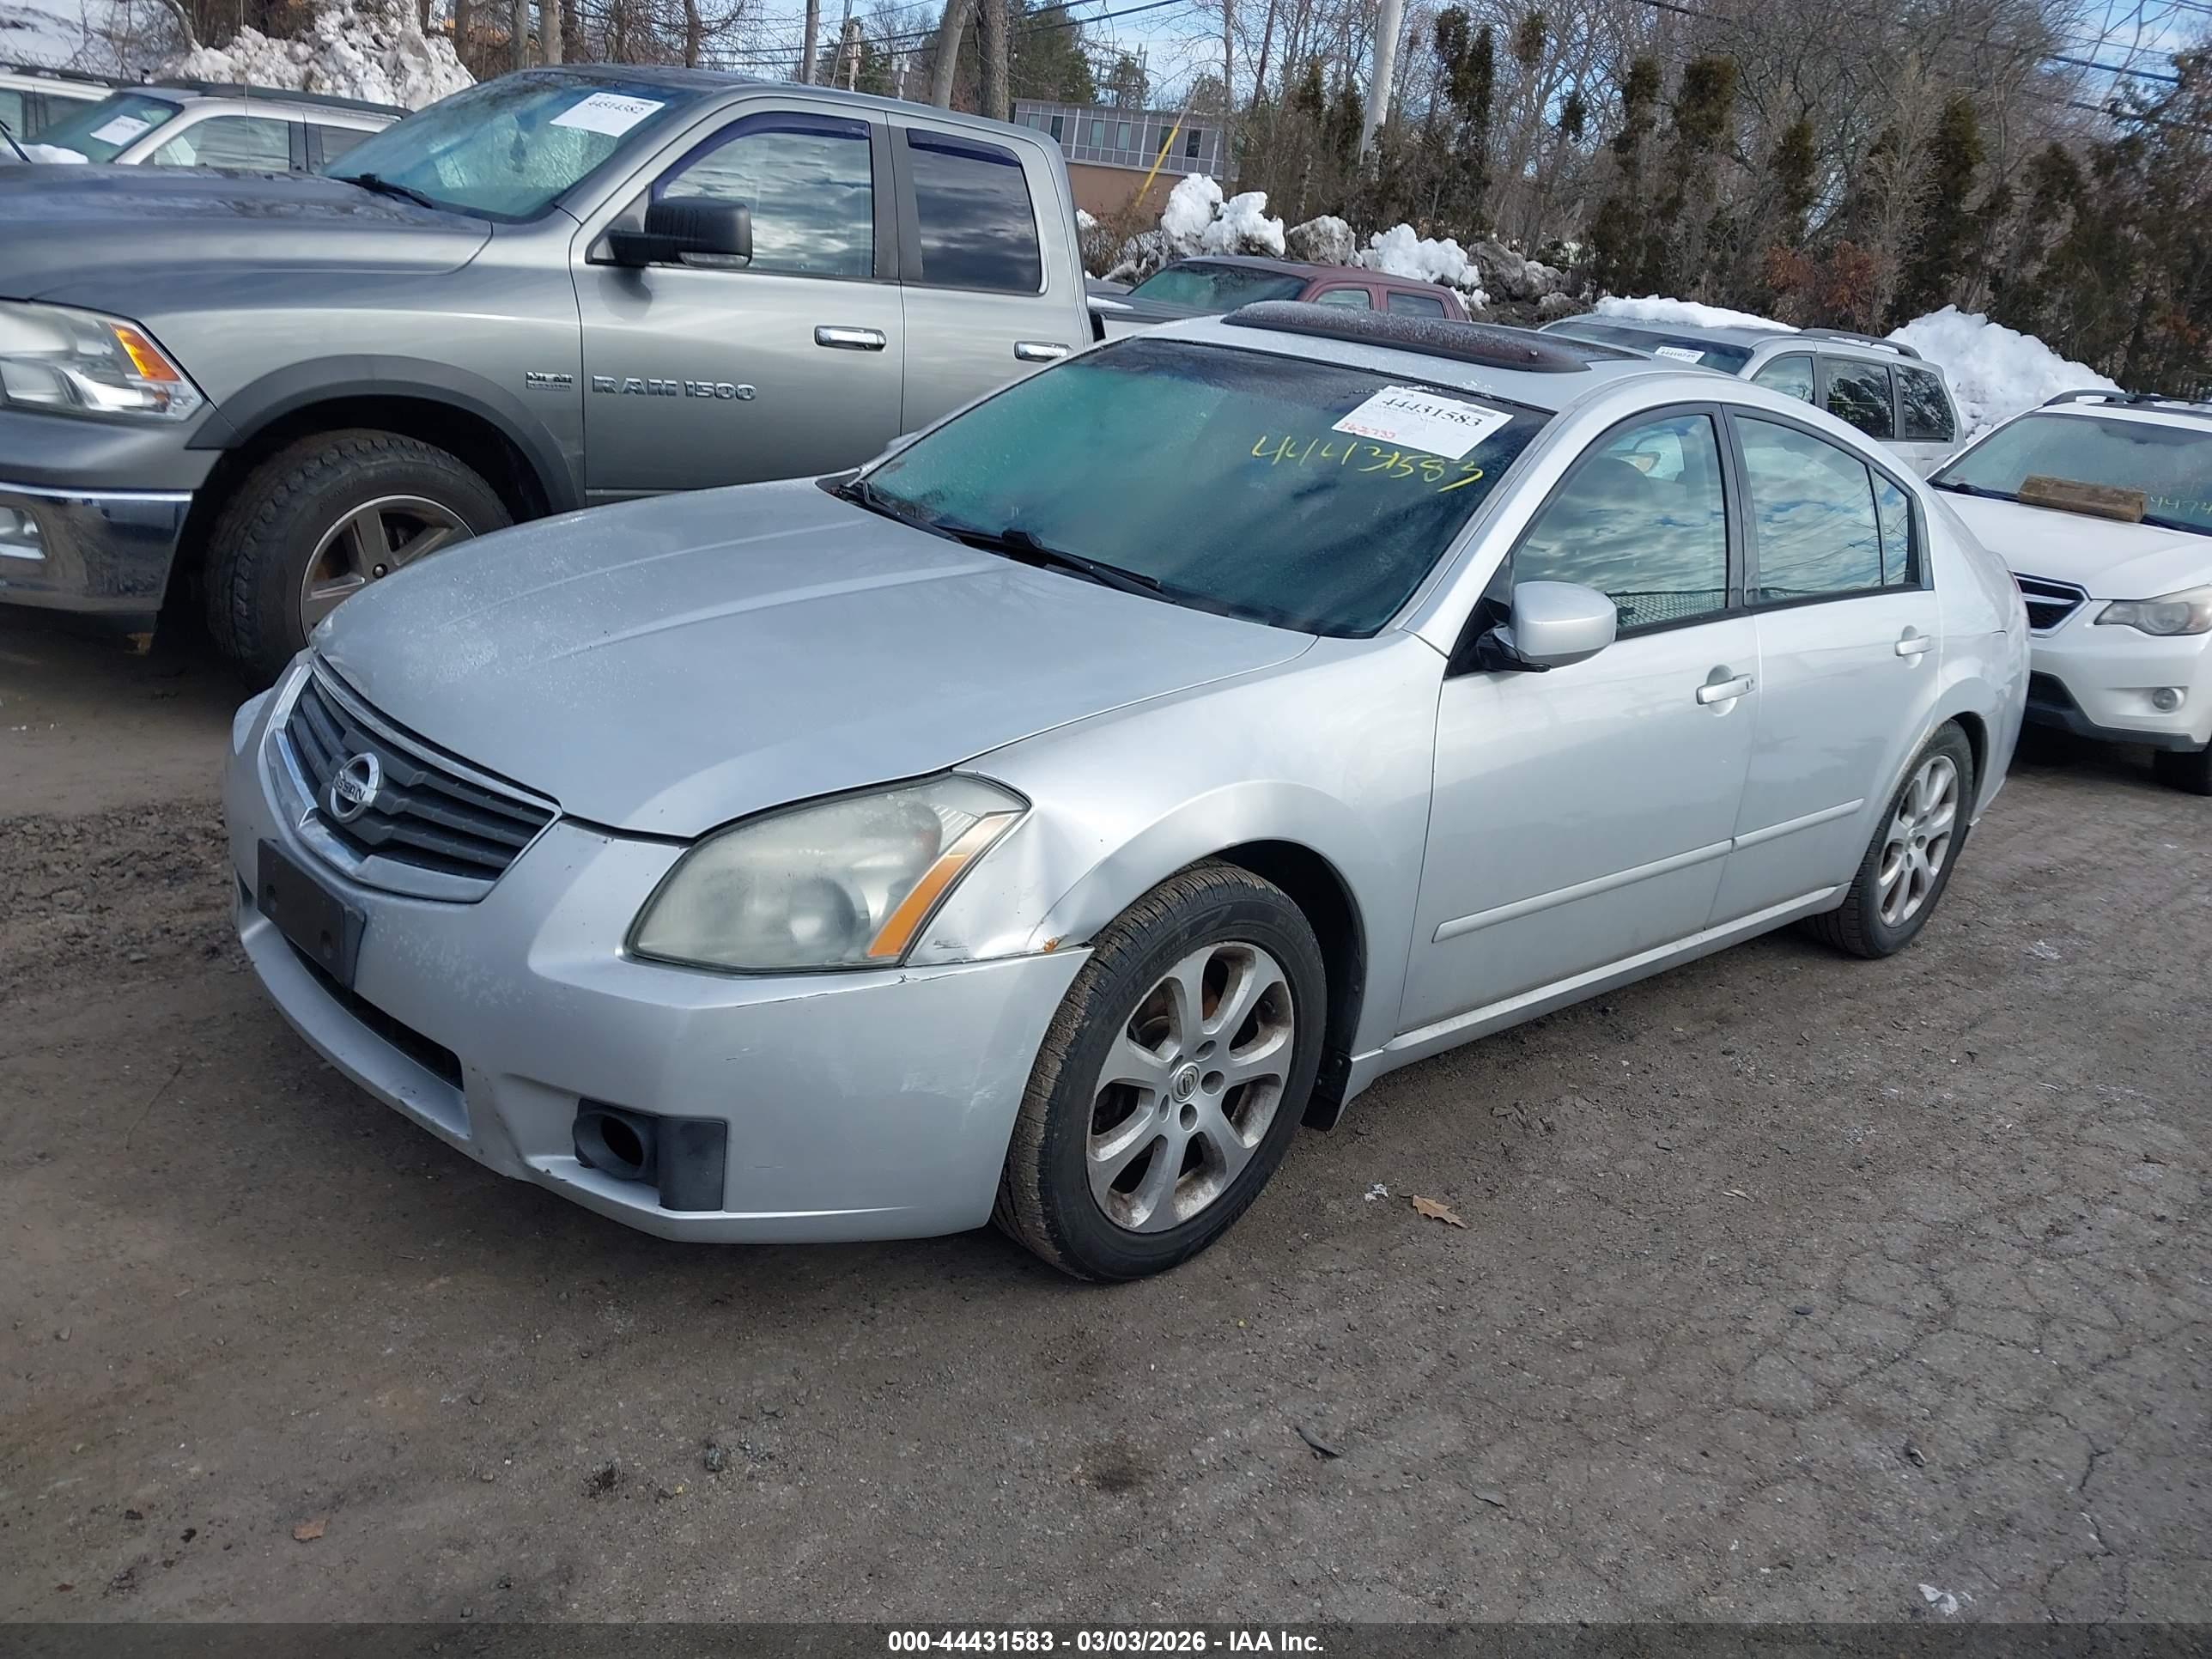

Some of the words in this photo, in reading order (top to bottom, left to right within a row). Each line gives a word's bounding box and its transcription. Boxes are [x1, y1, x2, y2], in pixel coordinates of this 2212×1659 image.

[592, 374, 678, 397] RAM
[684, 380, 757, 401] 1500
[1382, 398, 1483, 427] 44431583
[334, 775, 367, 802] SSAN
